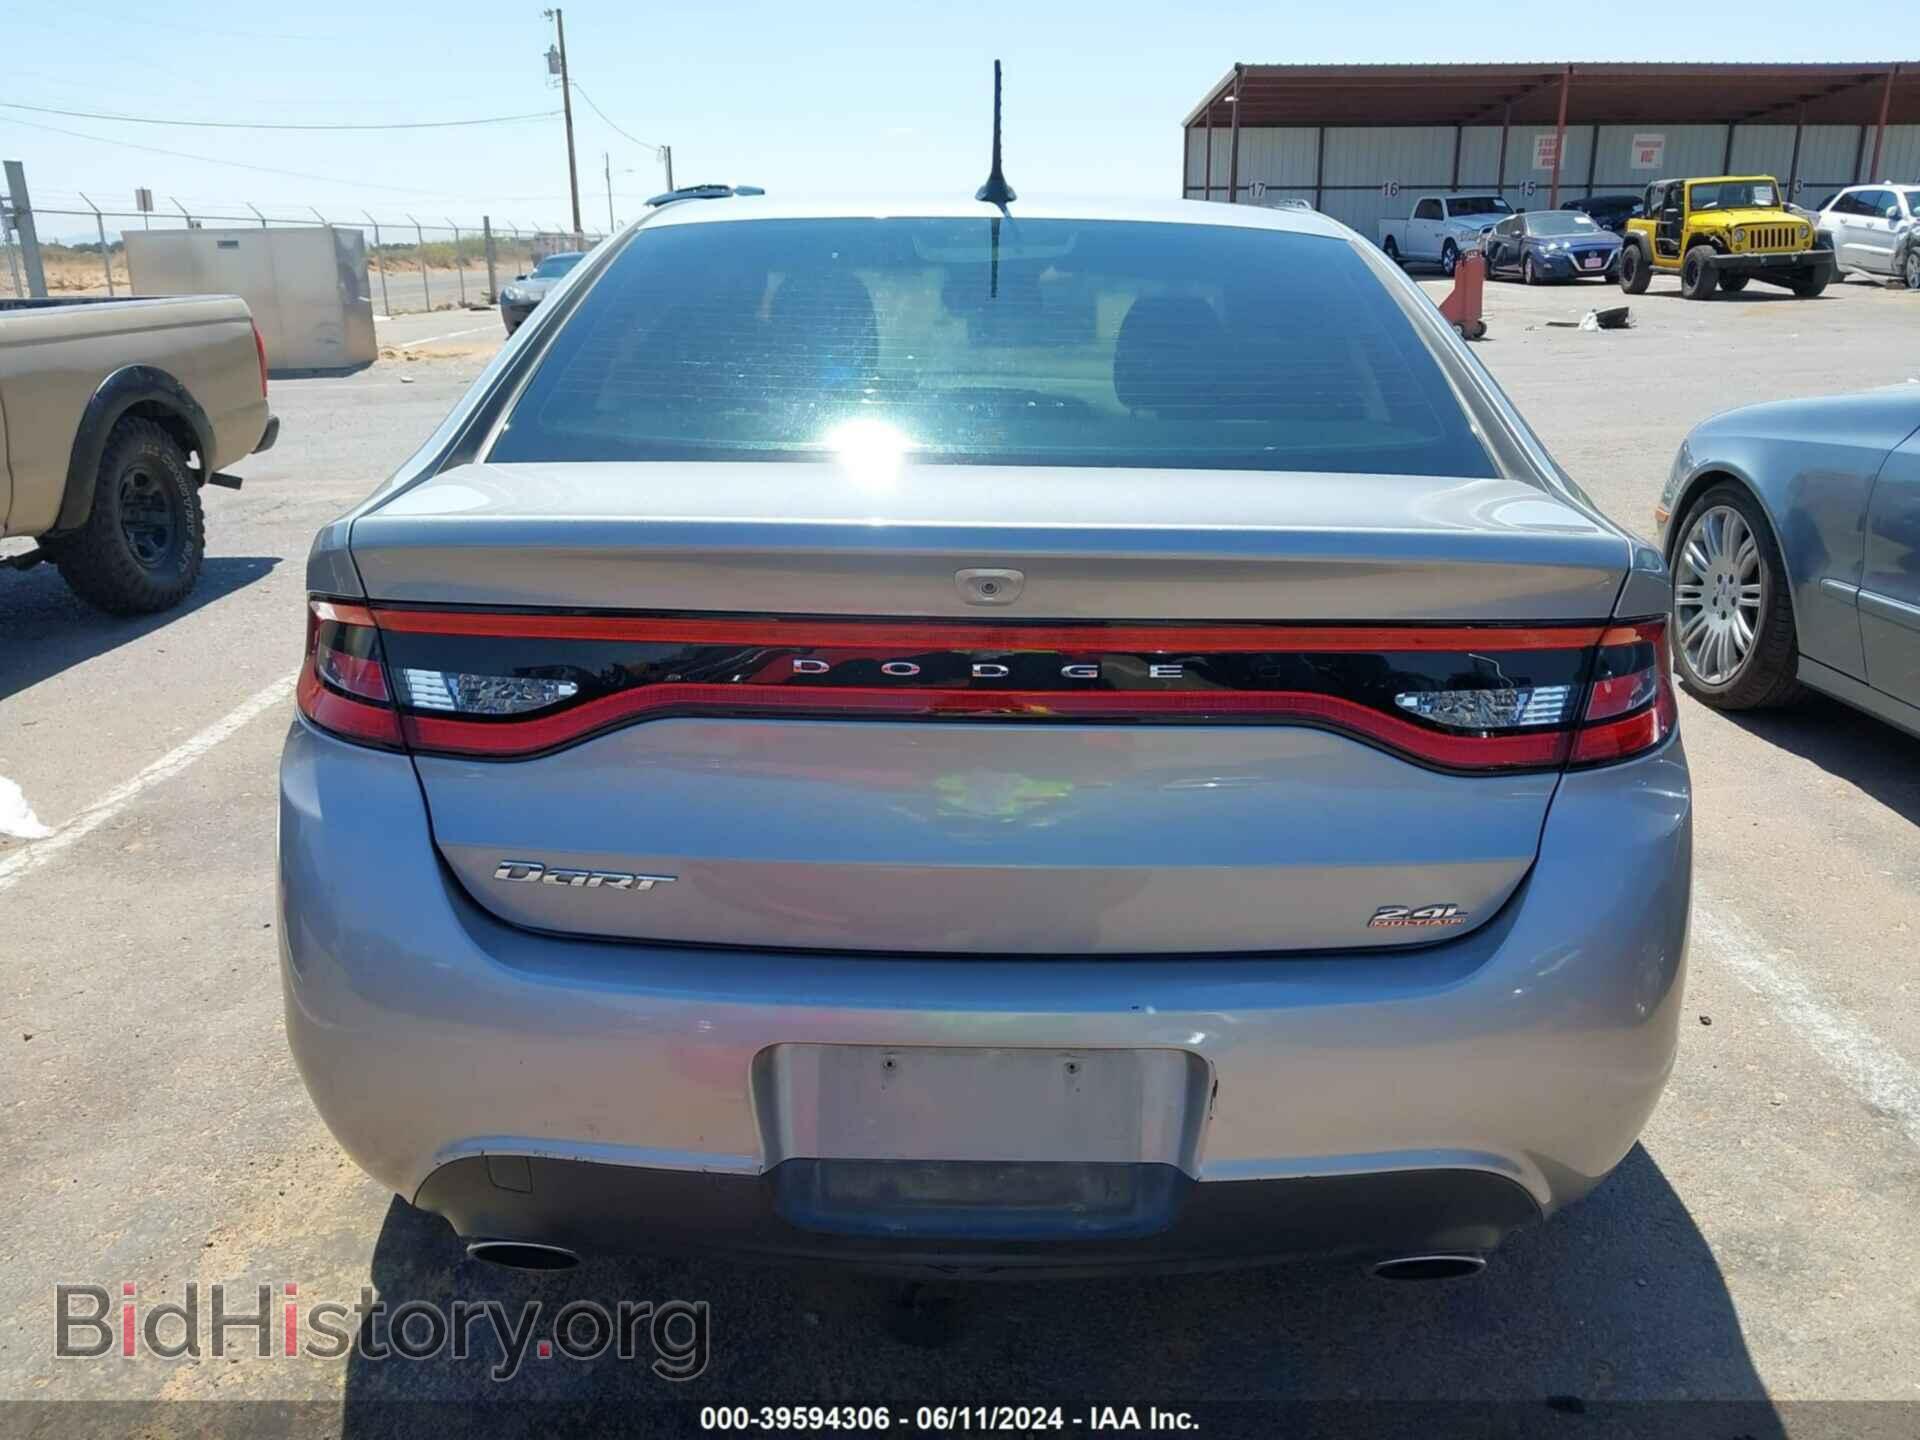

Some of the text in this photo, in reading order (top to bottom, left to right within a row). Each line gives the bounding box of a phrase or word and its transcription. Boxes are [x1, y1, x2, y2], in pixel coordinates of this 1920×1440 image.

[1250, 182, 1265, 197] 17
[1383, 181, 1399, 197] 16
[1520, 181, 1536, 196] 15
[792, 658, 1184, 680] DODGE
